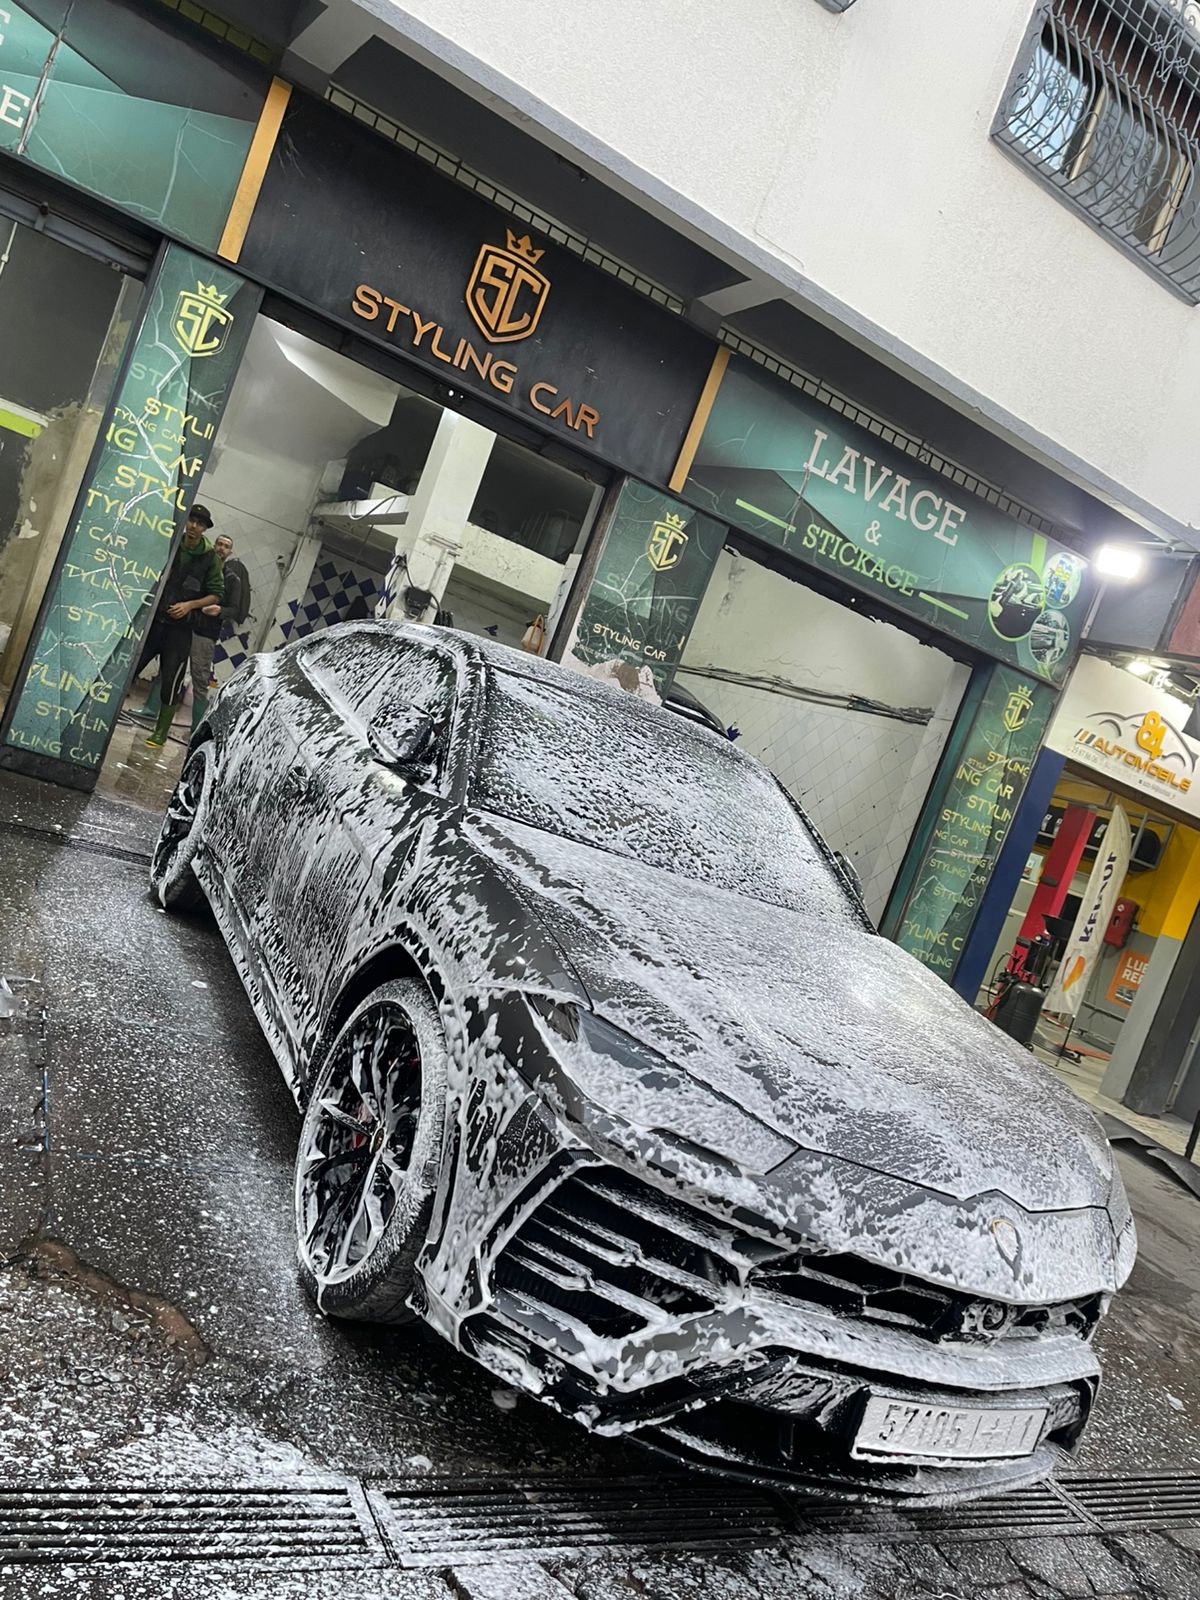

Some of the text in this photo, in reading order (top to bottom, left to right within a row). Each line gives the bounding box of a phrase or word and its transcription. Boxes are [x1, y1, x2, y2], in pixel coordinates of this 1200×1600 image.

[352, 284, 600, 438] STYLING CAR
[144, 397, 215, 440] STYLI
[161, 429, 187, 447] CAR
[114, 464, 187, 511] STYL
[803, 429, 967, 546] LAVAGE
[86, 488, 177, 538] TYLING
[88, 526, 129, 550] CAR
[864, 519, 882, 546] &
[802, 523, 919, 597] STICKAGE
[593, 623, 641, 650] STYLING
[643, 645, 667, 661] CAR
[985, 779, 1014, 799] CAR
[942, 809, 992, 837] STYLING
[950, 834, 969, 848] CAR
[929, 858, 987, 885] STYLING CAR
[911, 947, 953, 969] STYLING
